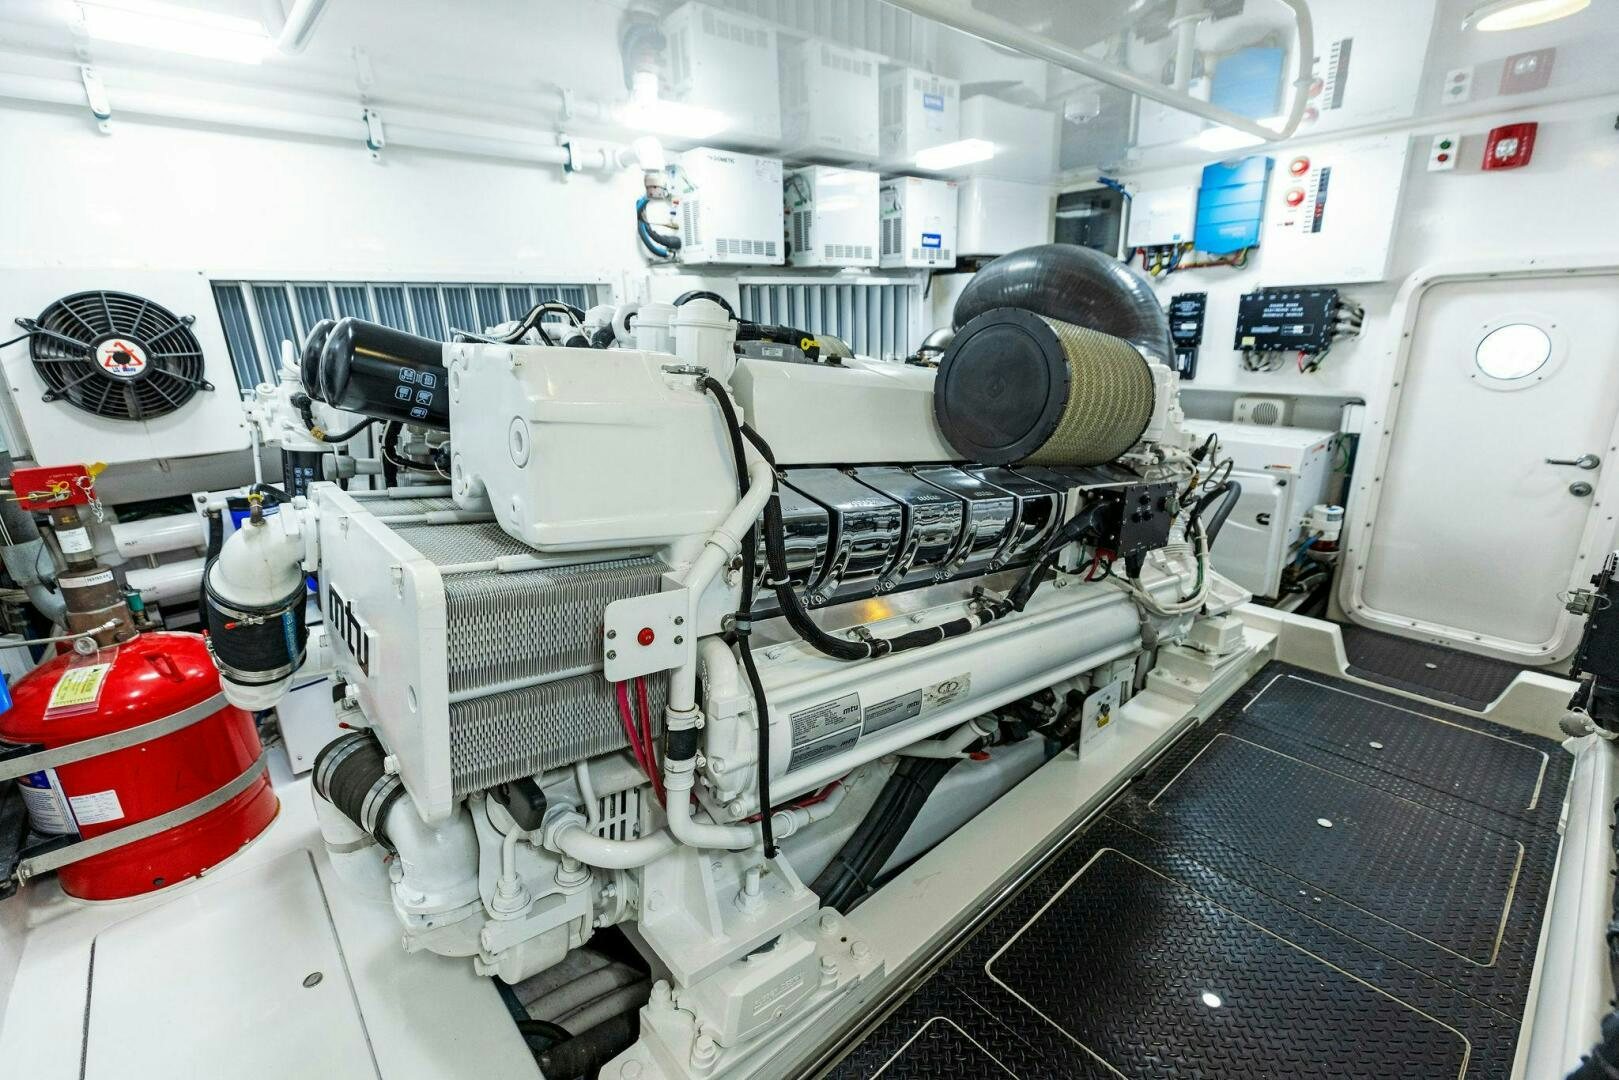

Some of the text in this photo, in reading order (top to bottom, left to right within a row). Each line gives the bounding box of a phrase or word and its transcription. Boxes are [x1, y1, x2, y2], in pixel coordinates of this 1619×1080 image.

[328, 583, 369, 678] mtu
[842, 704, 858, 715] mtu
[906, 700, 920, 711] mtu
